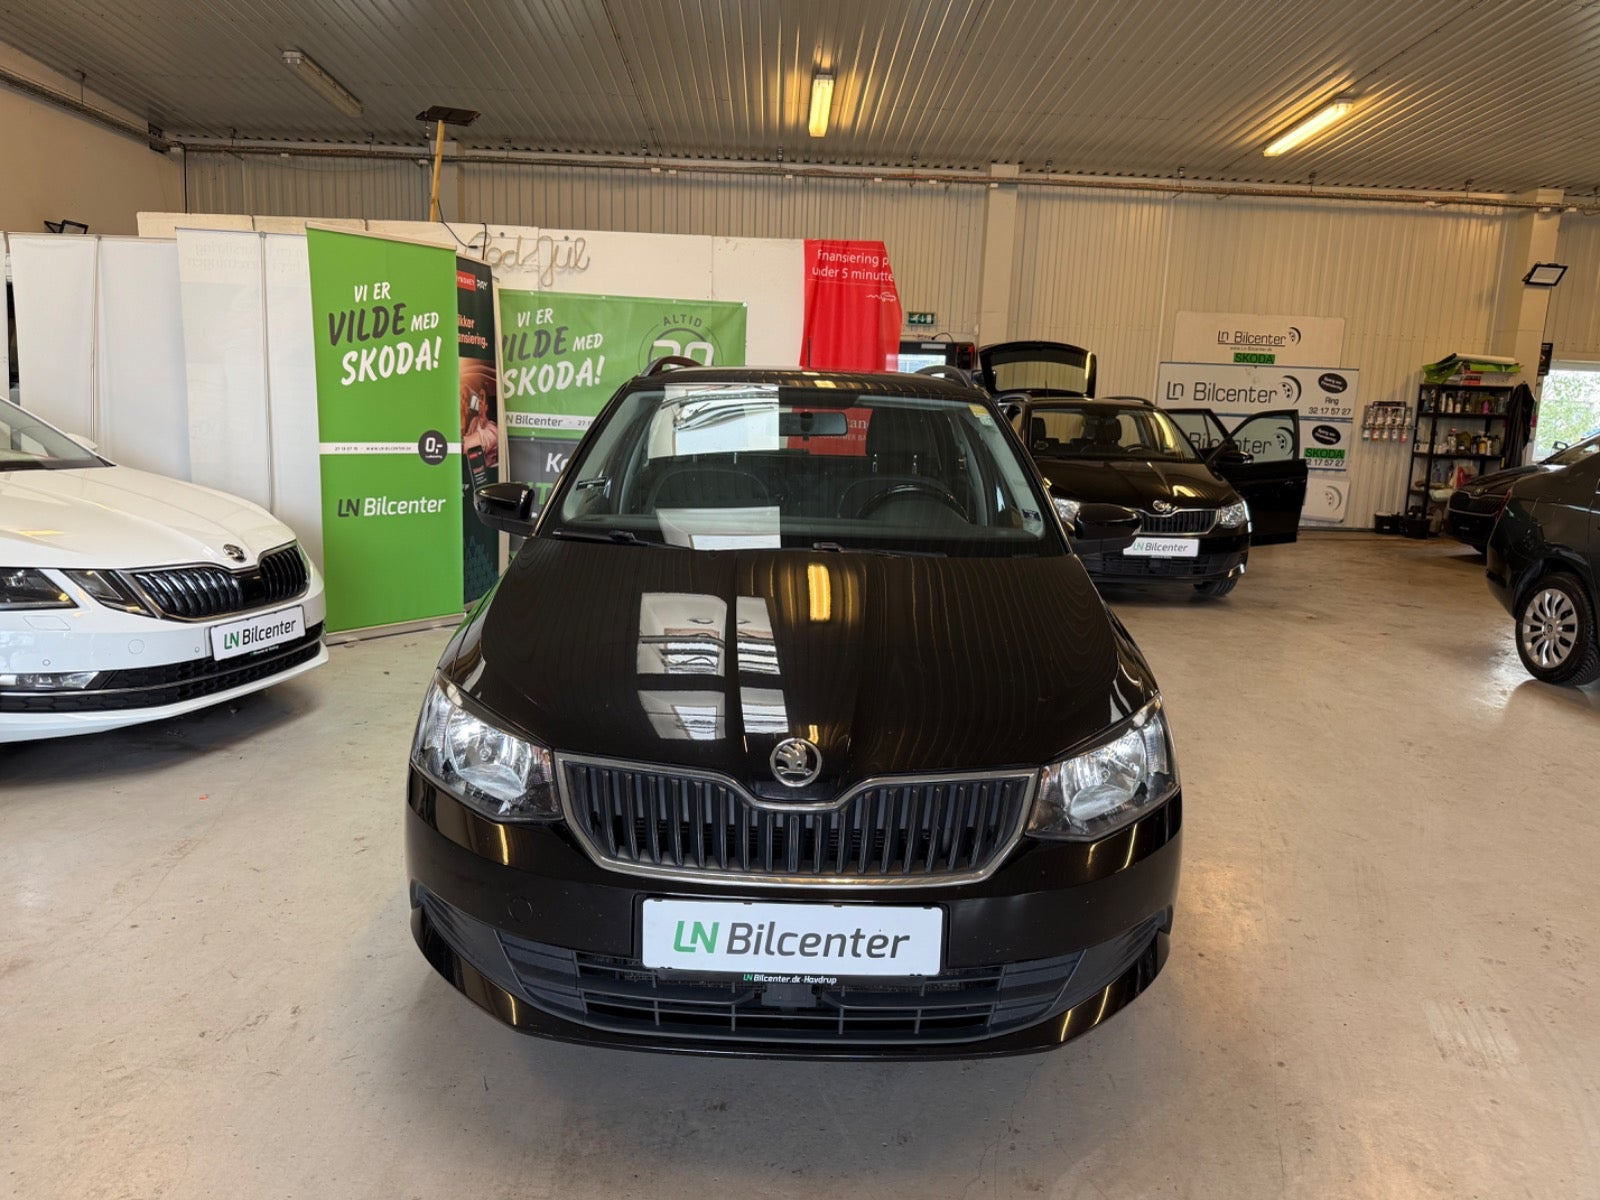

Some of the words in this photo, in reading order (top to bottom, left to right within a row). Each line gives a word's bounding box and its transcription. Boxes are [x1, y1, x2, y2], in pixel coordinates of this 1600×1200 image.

[817, 249, 879, 268] Fnansiering
[812, 266, 840, 278] uder
[842, 268, 848, 278] 5
[354, 284, 368, 303] VI
[373, 282, 391, 300] ER
[328, 303, 407, 347] VILDE
[410, 312, 439, 332] MED
[517, 311, 531, 328] VI
[536, 308, 554, 325] ER
[663, 313, 703, 328] ALTID
[572, 333, 604, 352] MED
[1234, 331, 1287, 345] Bilcenter
[341, 336, 442, 386] SKODA!
[1233, 353, 1275, 364] SKODA
[503, 355, 606, 399] SKODA!
[1193, 382, 1278, 404] Bilcenter
[515, 414, 564, 427] Bilcenter
[1321, 407, 1330, 415] 17
[1305, 447, 1345, 459] SKODA
[338, 499, 360, 517] LN
[363, 496, 446, 517] Bilcenter
[1145, 542, 1188, 552] Bilcenter
[224, 631, 240, 650] LN
[242, 620, 296, 646] Bilcenter
[673, 920, 720, 953] LN
[726, 921, 911, 959] Bilcenter
